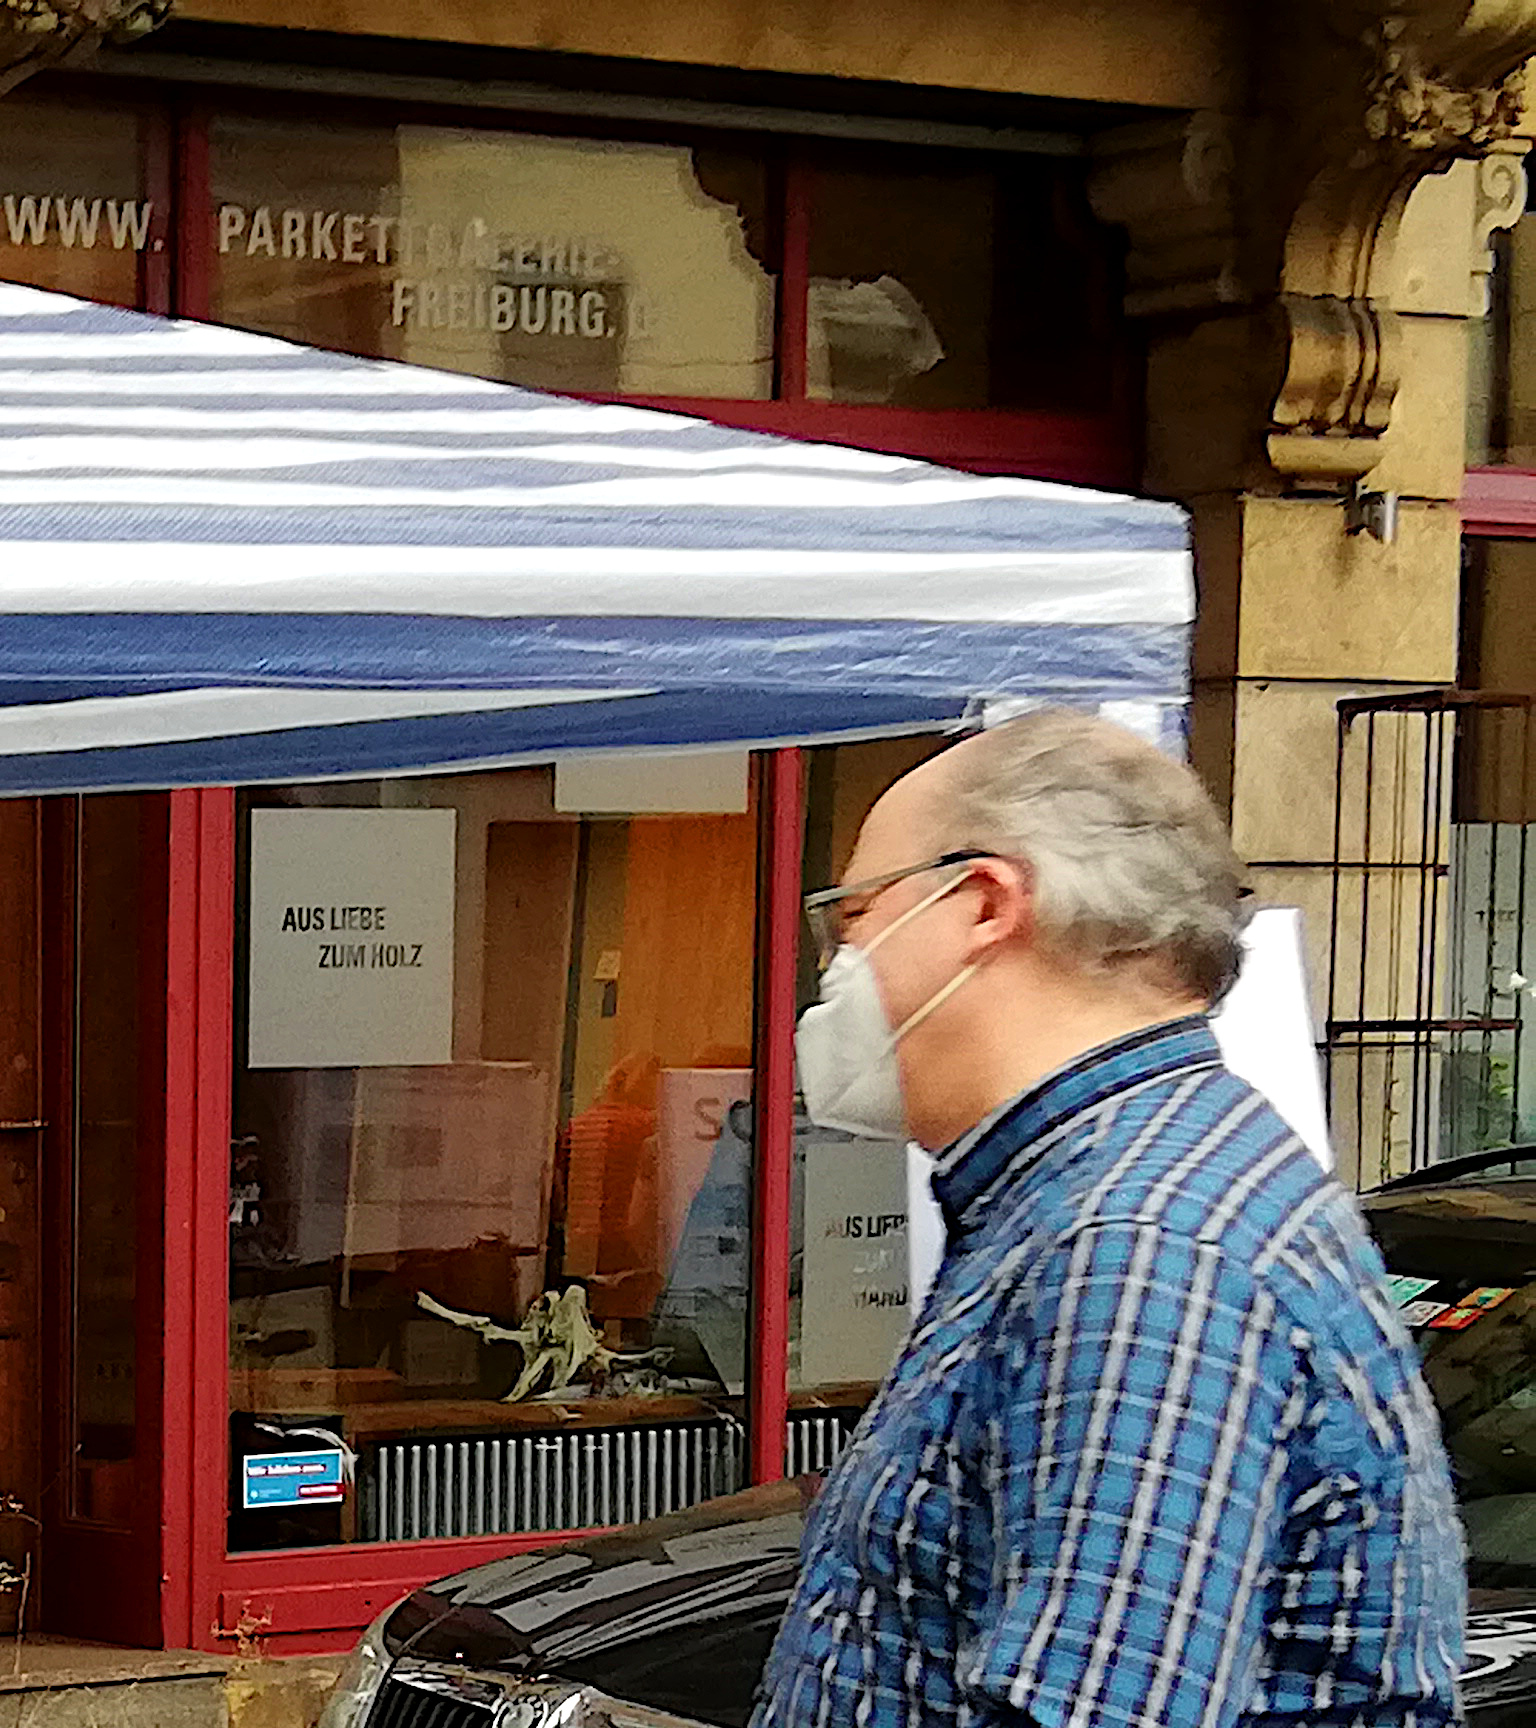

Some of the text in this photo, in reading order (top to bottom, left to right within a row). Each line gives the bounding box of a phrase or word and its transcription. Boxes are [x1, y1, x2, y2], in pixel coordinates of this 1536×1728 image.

[3, 194, 166, 253] WWW.
[281, 906, 387, 933] AUS LIEBE
[318, 943, 423, 970] ZUM HOLZ
